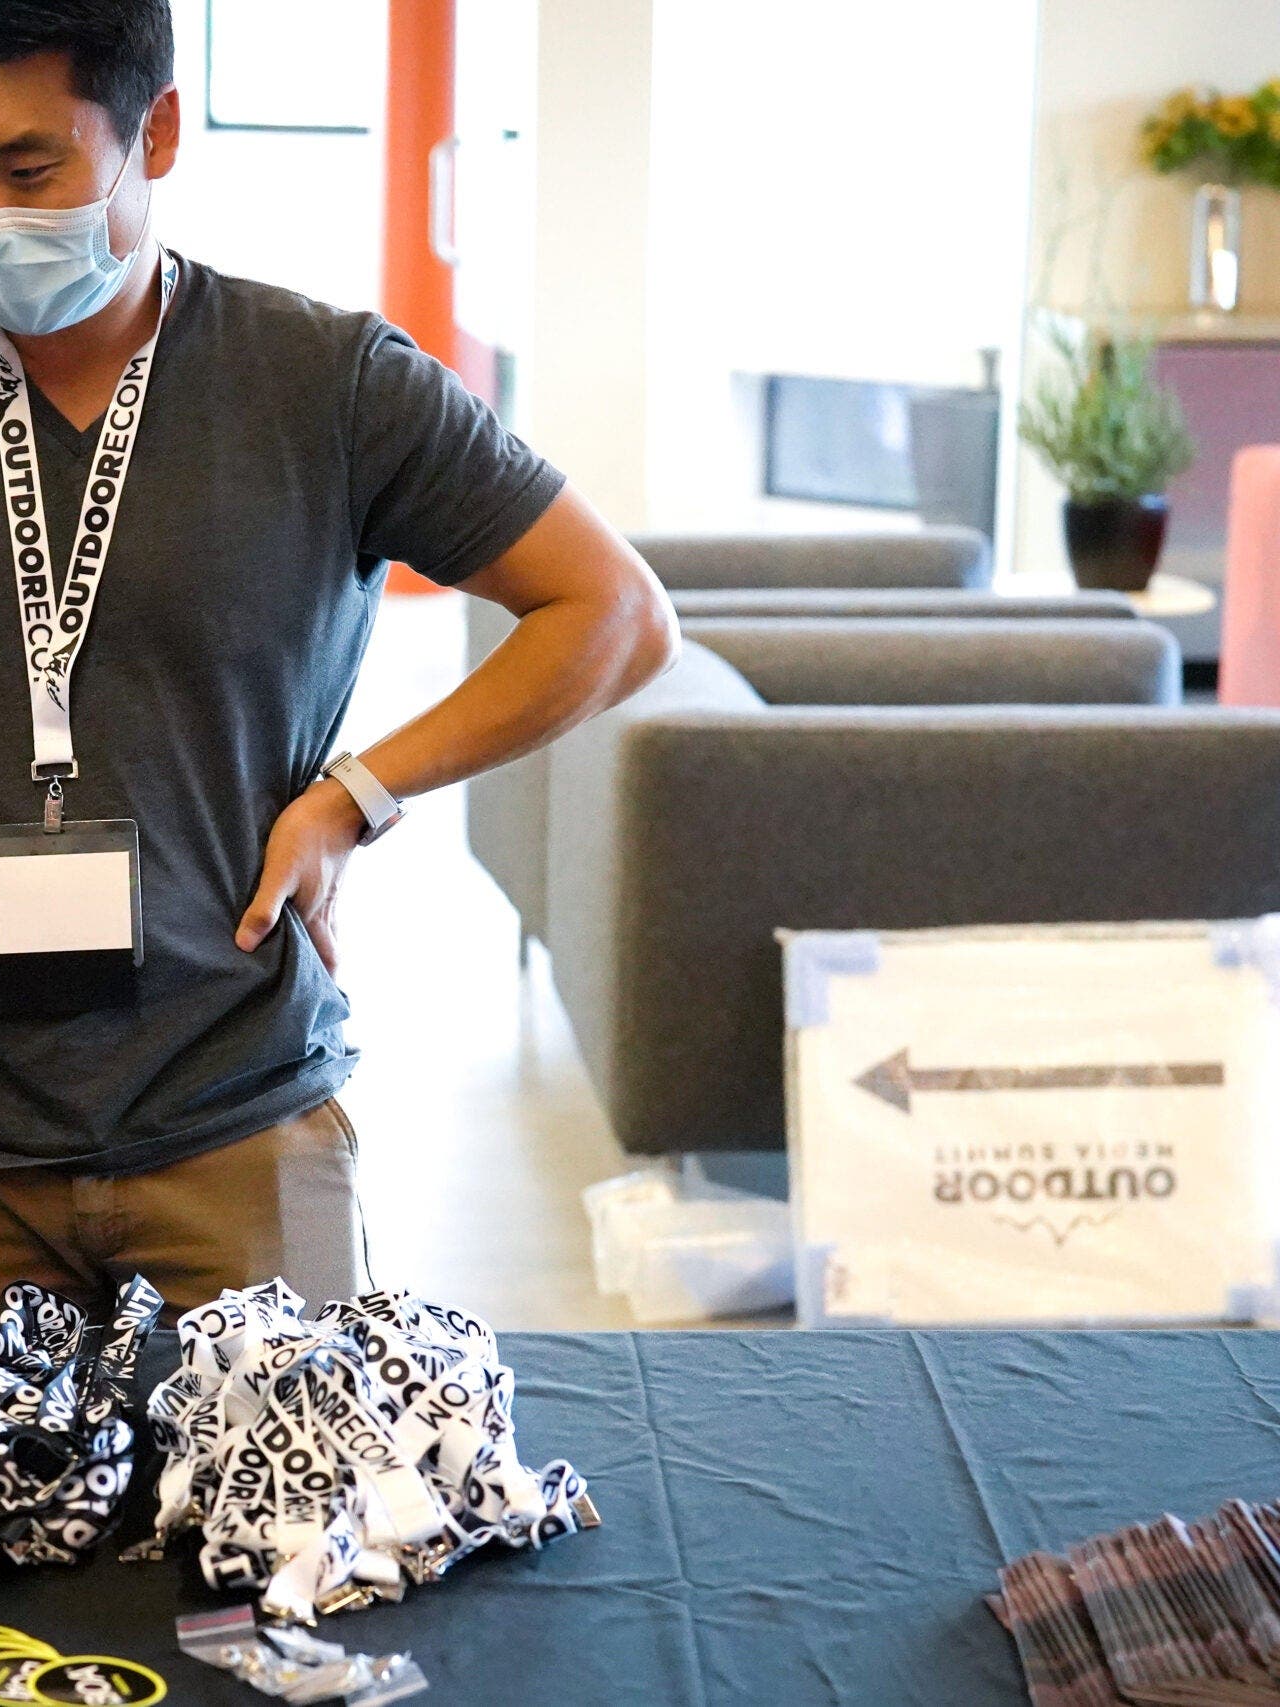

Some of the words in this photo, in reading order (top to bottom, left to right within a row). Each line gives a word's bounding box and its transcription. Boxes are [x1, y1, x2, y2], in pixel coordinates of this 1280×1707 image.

[1, 418, 54, 676] OUTDOORECO
[60, 357, 147, 634] OUTDOORECOM
[934, 1167, 1176, 1203] OUTDOOR
